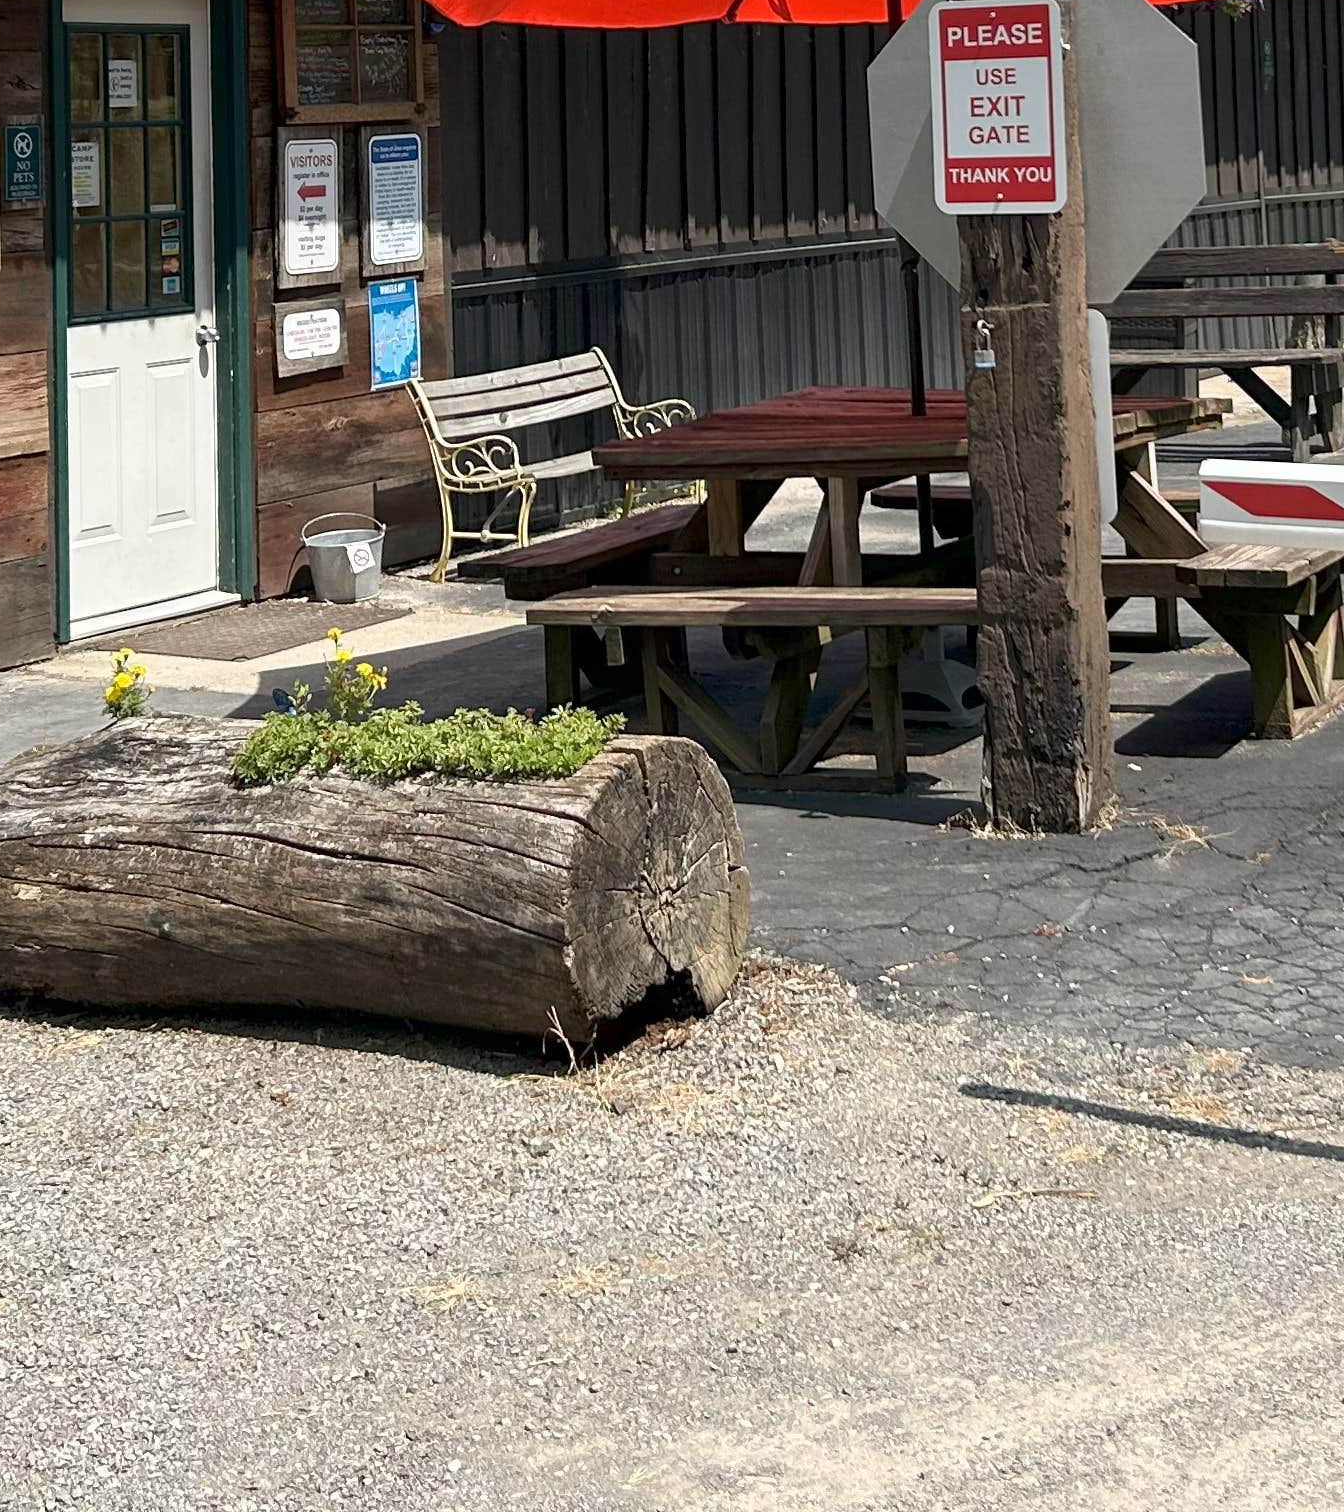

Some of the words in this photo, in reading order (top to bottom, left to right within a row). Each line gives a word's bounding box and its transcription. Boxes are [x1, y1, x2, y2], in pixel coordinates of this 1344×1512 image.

[946, 23, 1043, 48] PLEASE
[976, 68, 1017, 86] USE
[970, 95, 1025, 118] EXIT
[969, 125, 1030, 144] GATE
[16, 160, 31, 172] NO
[290, 155, 333, 169] VISITORS
[13, 172, 35, 183] PETS
[949, 167, 1010, 184] THANK
[1015, 166, 1052, 183] YOU
